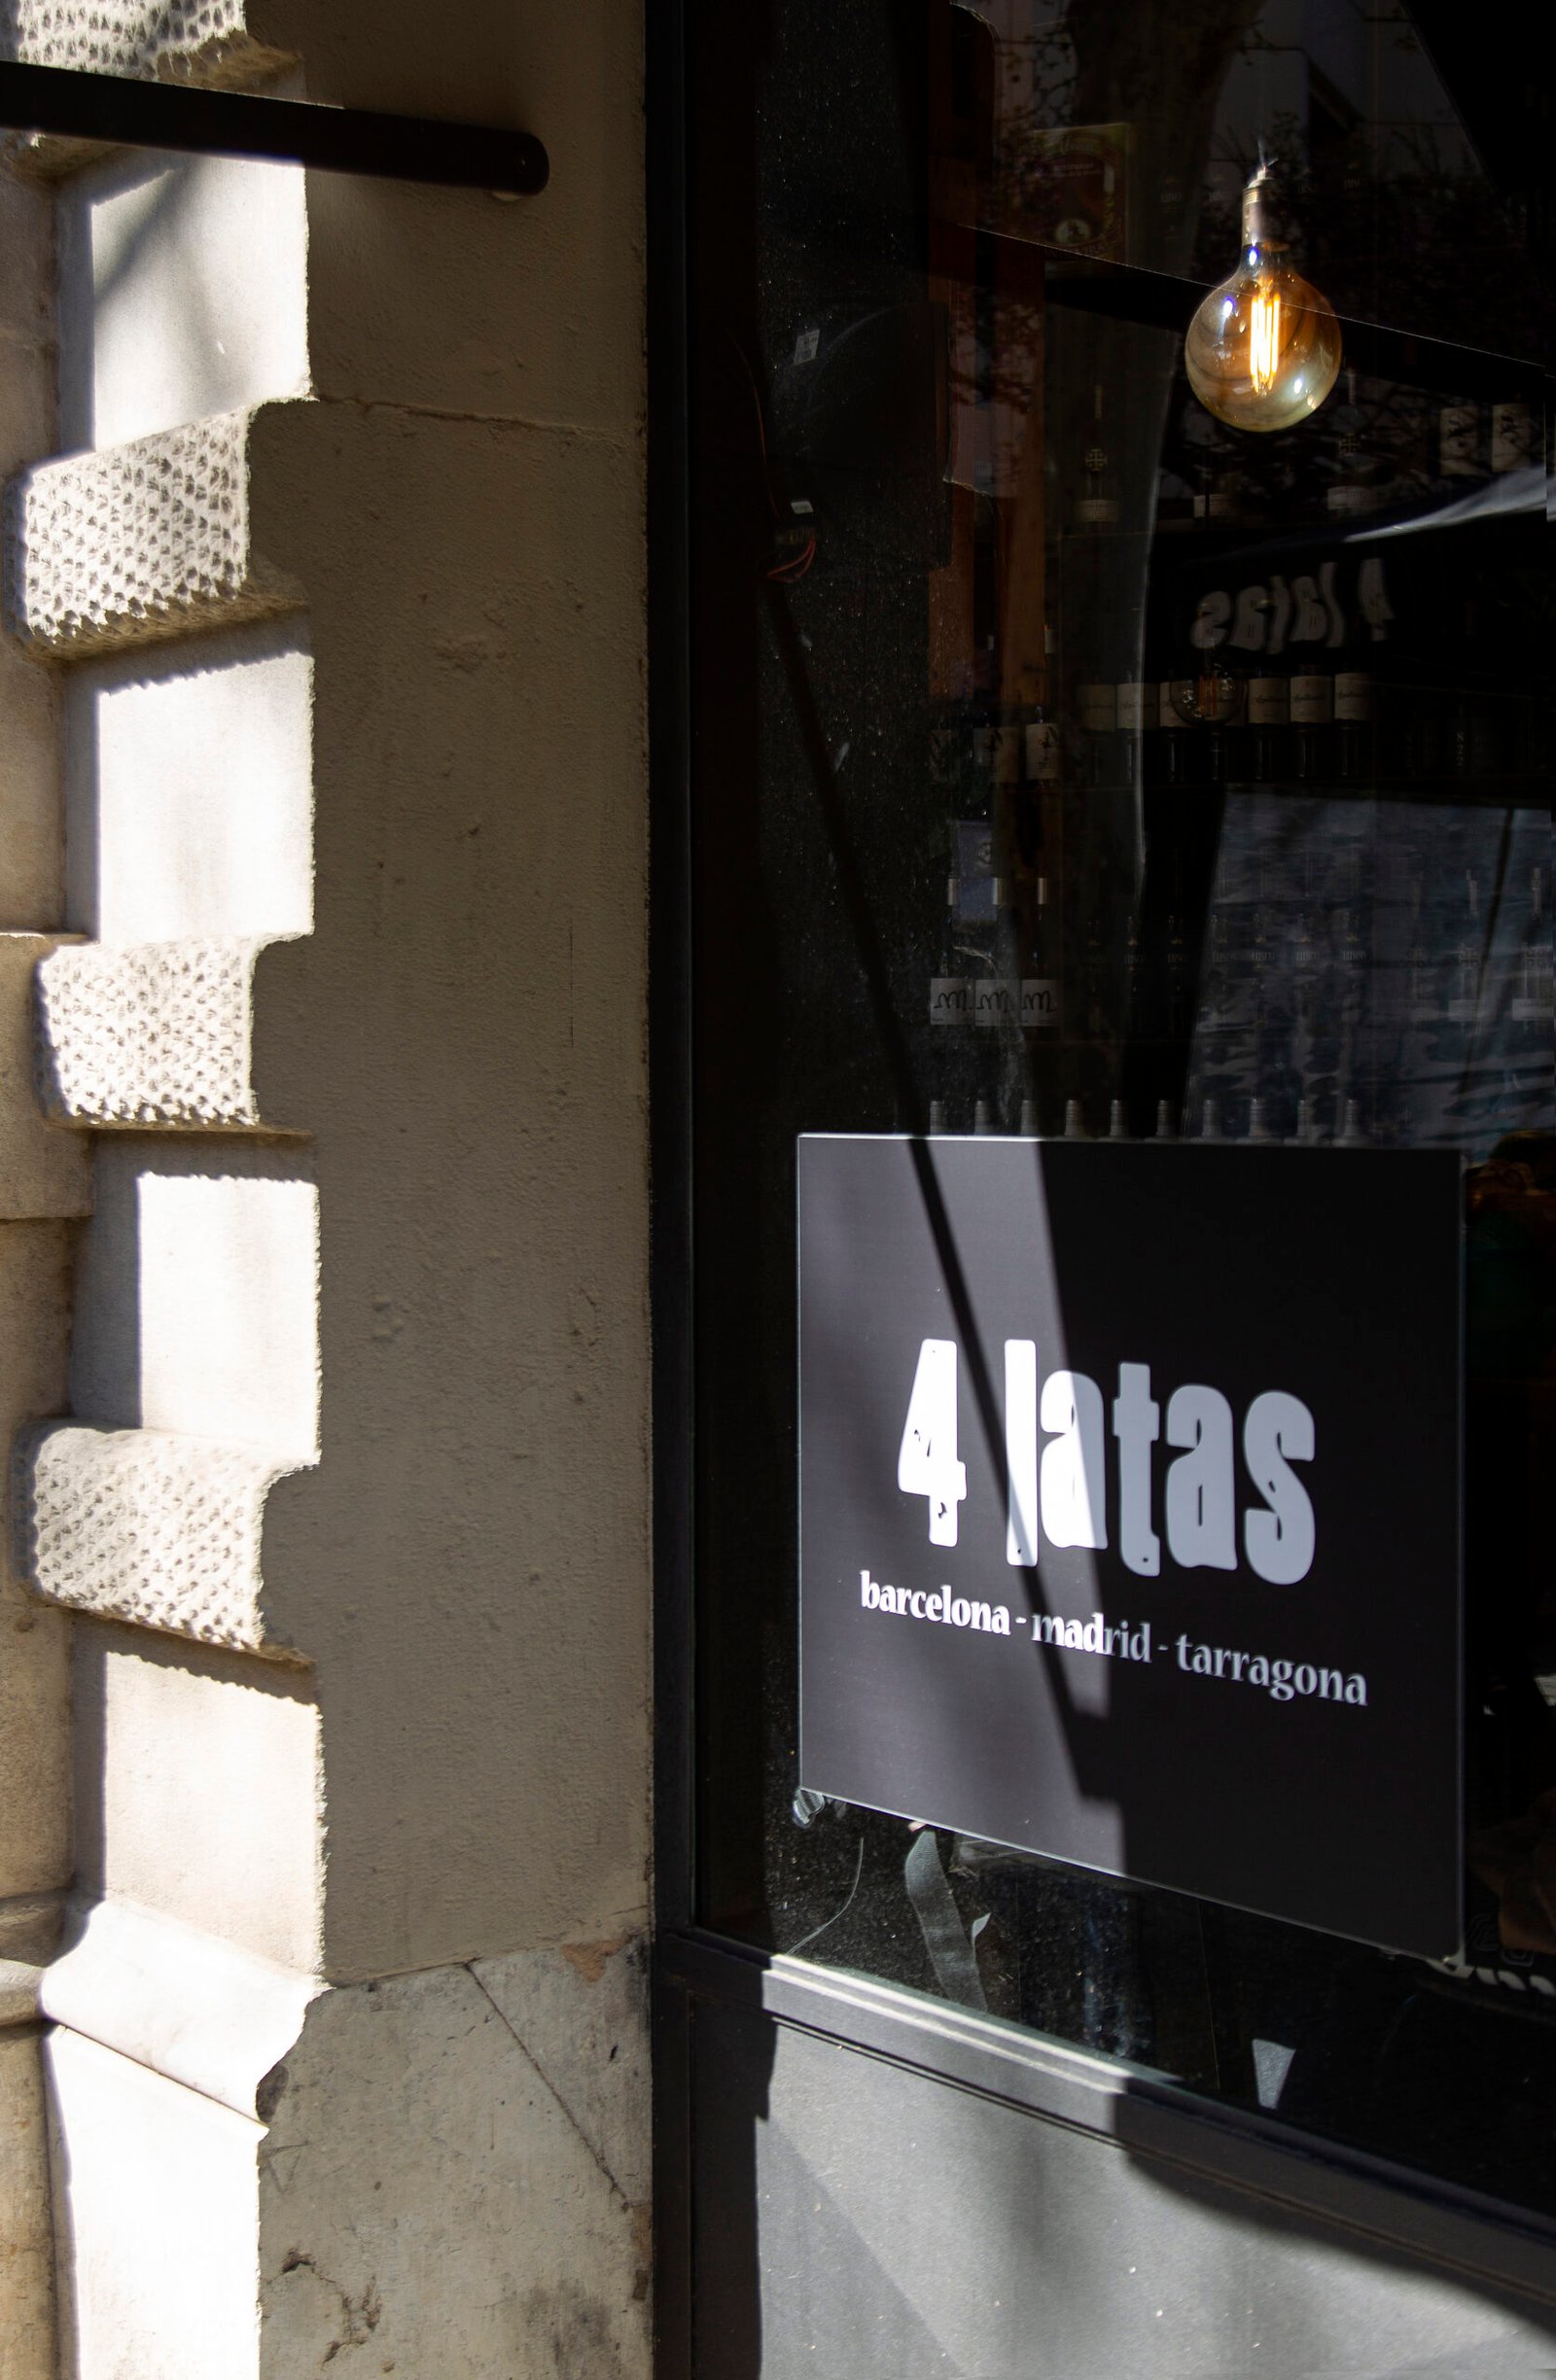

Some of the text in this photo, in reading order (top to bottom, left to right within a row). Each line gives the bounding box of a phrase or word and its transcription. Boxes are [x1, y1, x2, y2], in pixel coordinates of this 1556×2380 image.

[898, 1338, 1316, 1587] 4 latas
[860, 1569, 1011, 1635] barcelona
[1031, 1611, 1153, 1663] madrid
[1175, 1633, 1368, 1706] tarragona
